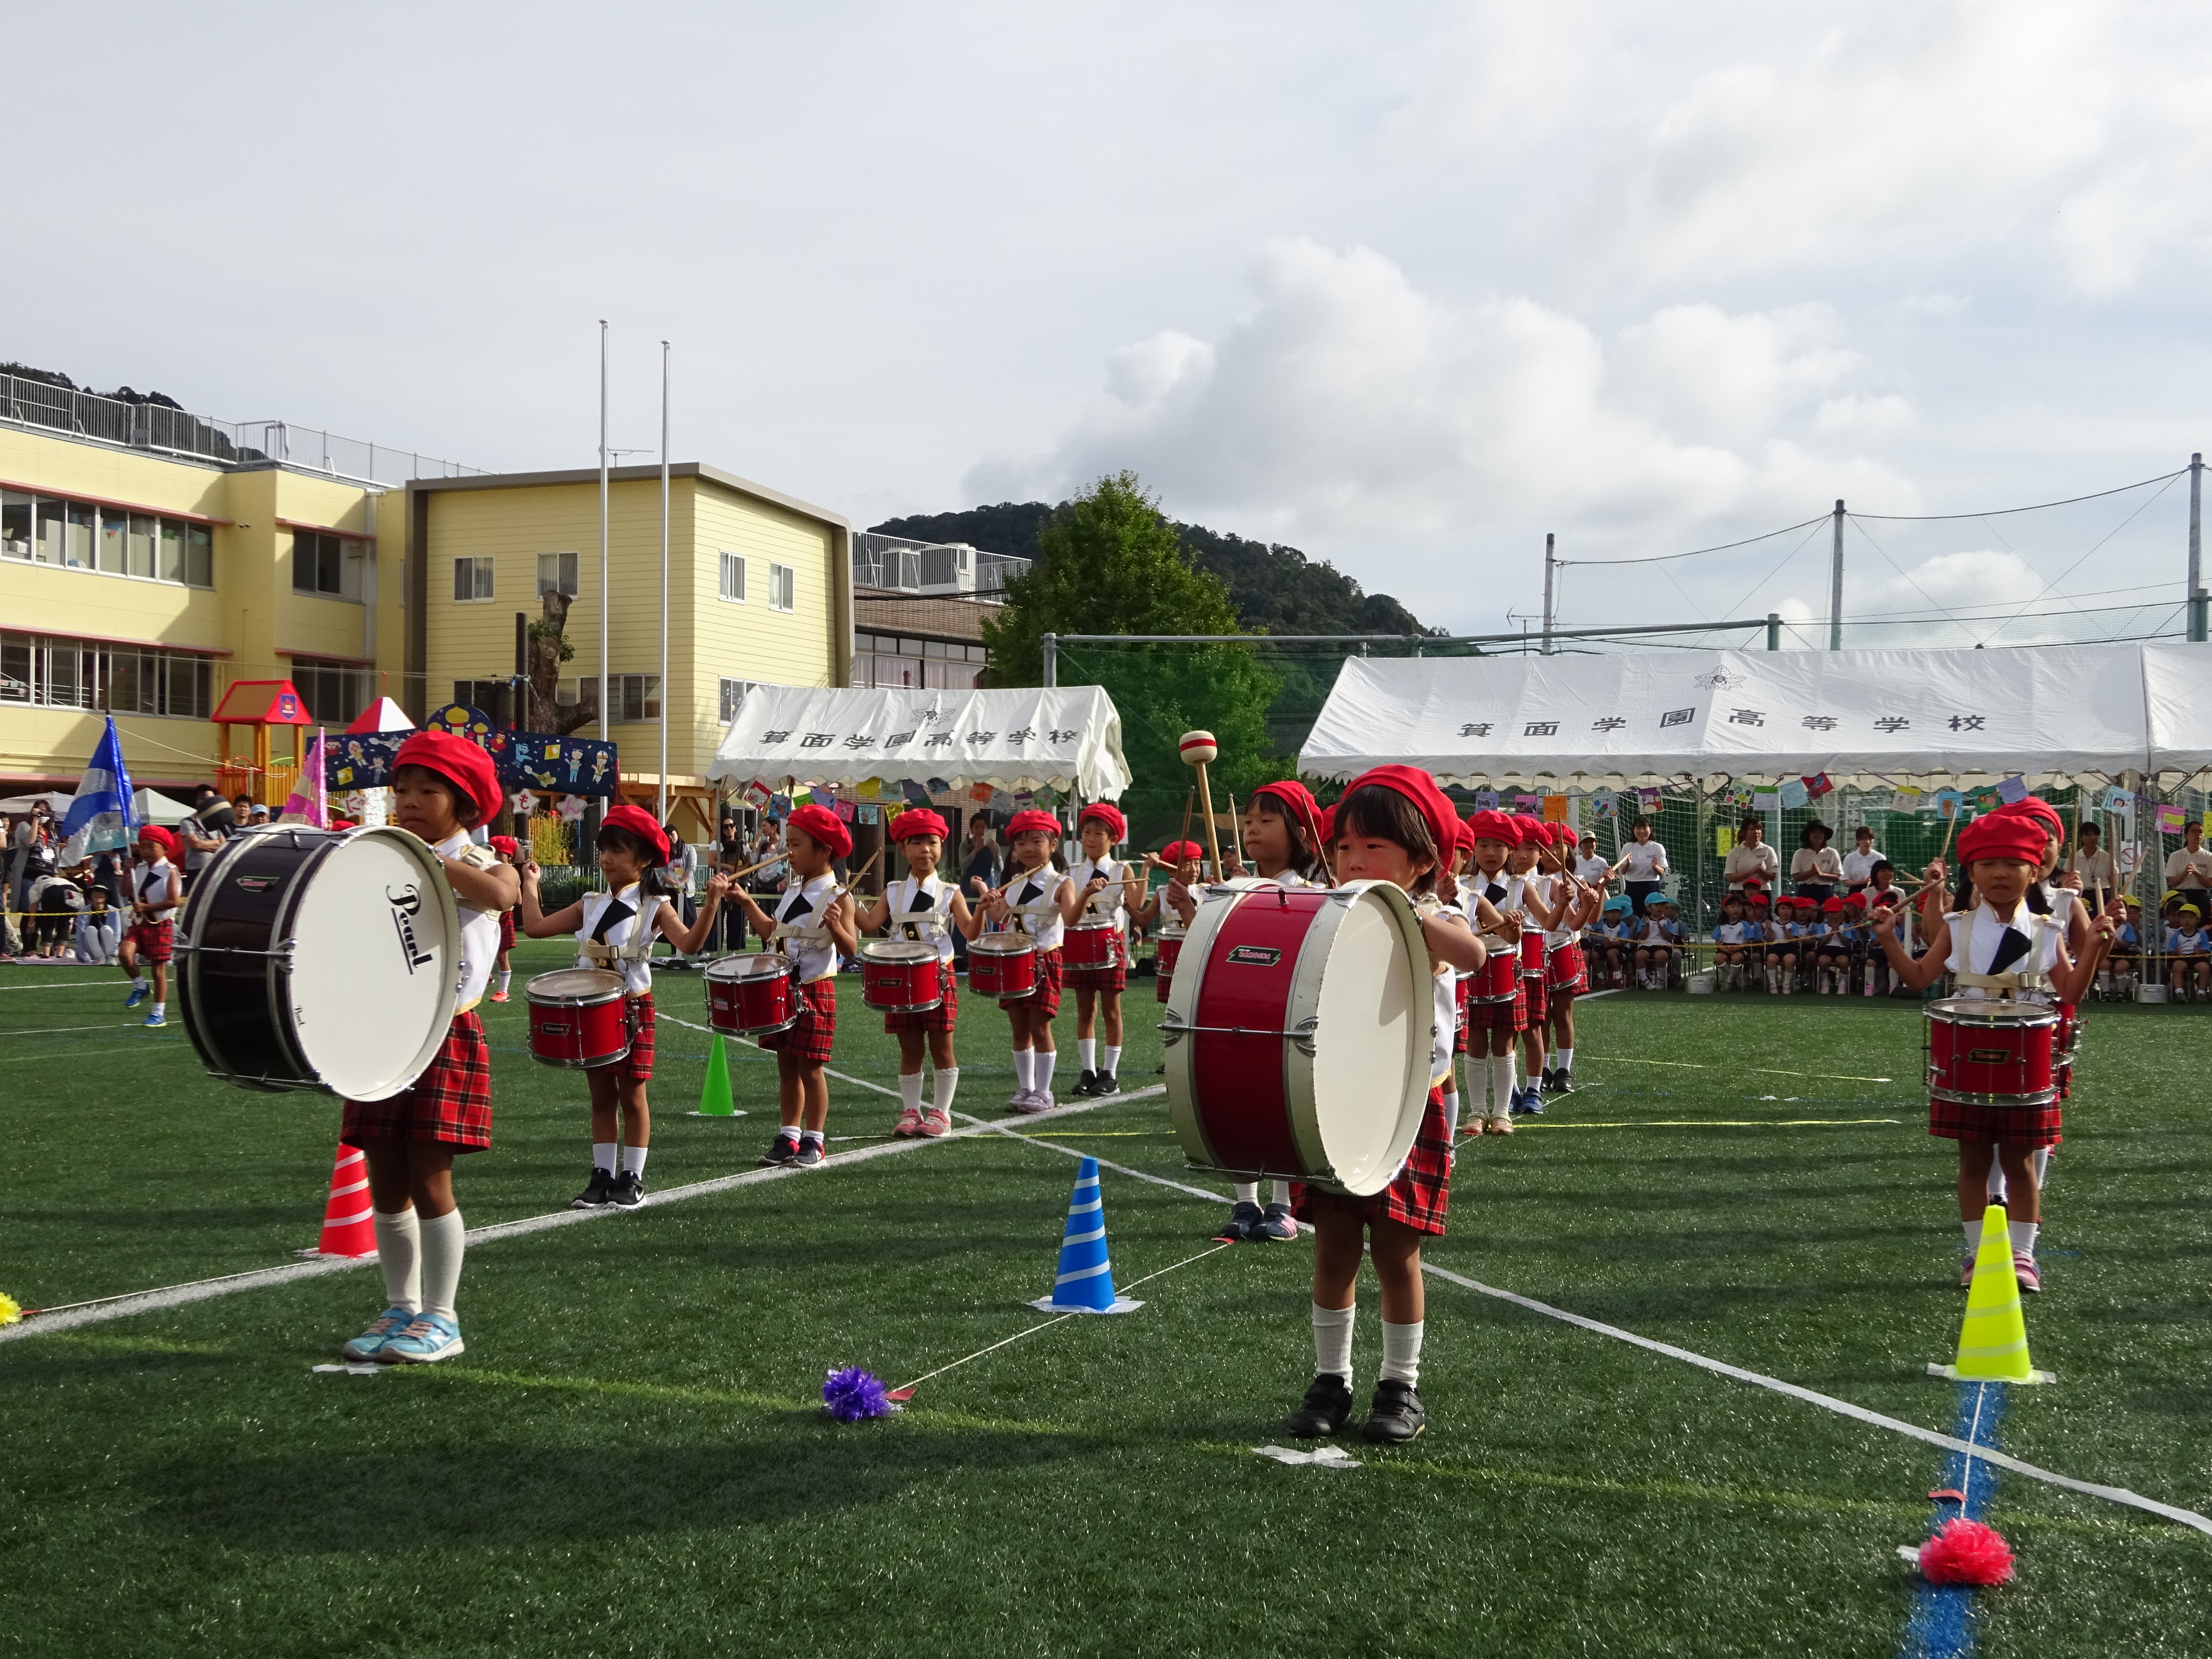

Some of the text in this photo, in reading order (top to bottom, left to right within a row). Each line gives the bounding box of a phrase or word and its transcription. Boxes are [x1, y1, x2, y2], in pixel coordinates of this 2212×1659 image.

[1457, 707, 1986, 737] 箕面学園高等学校
[759, 726, 1078, 750] 箕面学園高等学校
[386, 884, 433, 968] Pearl
